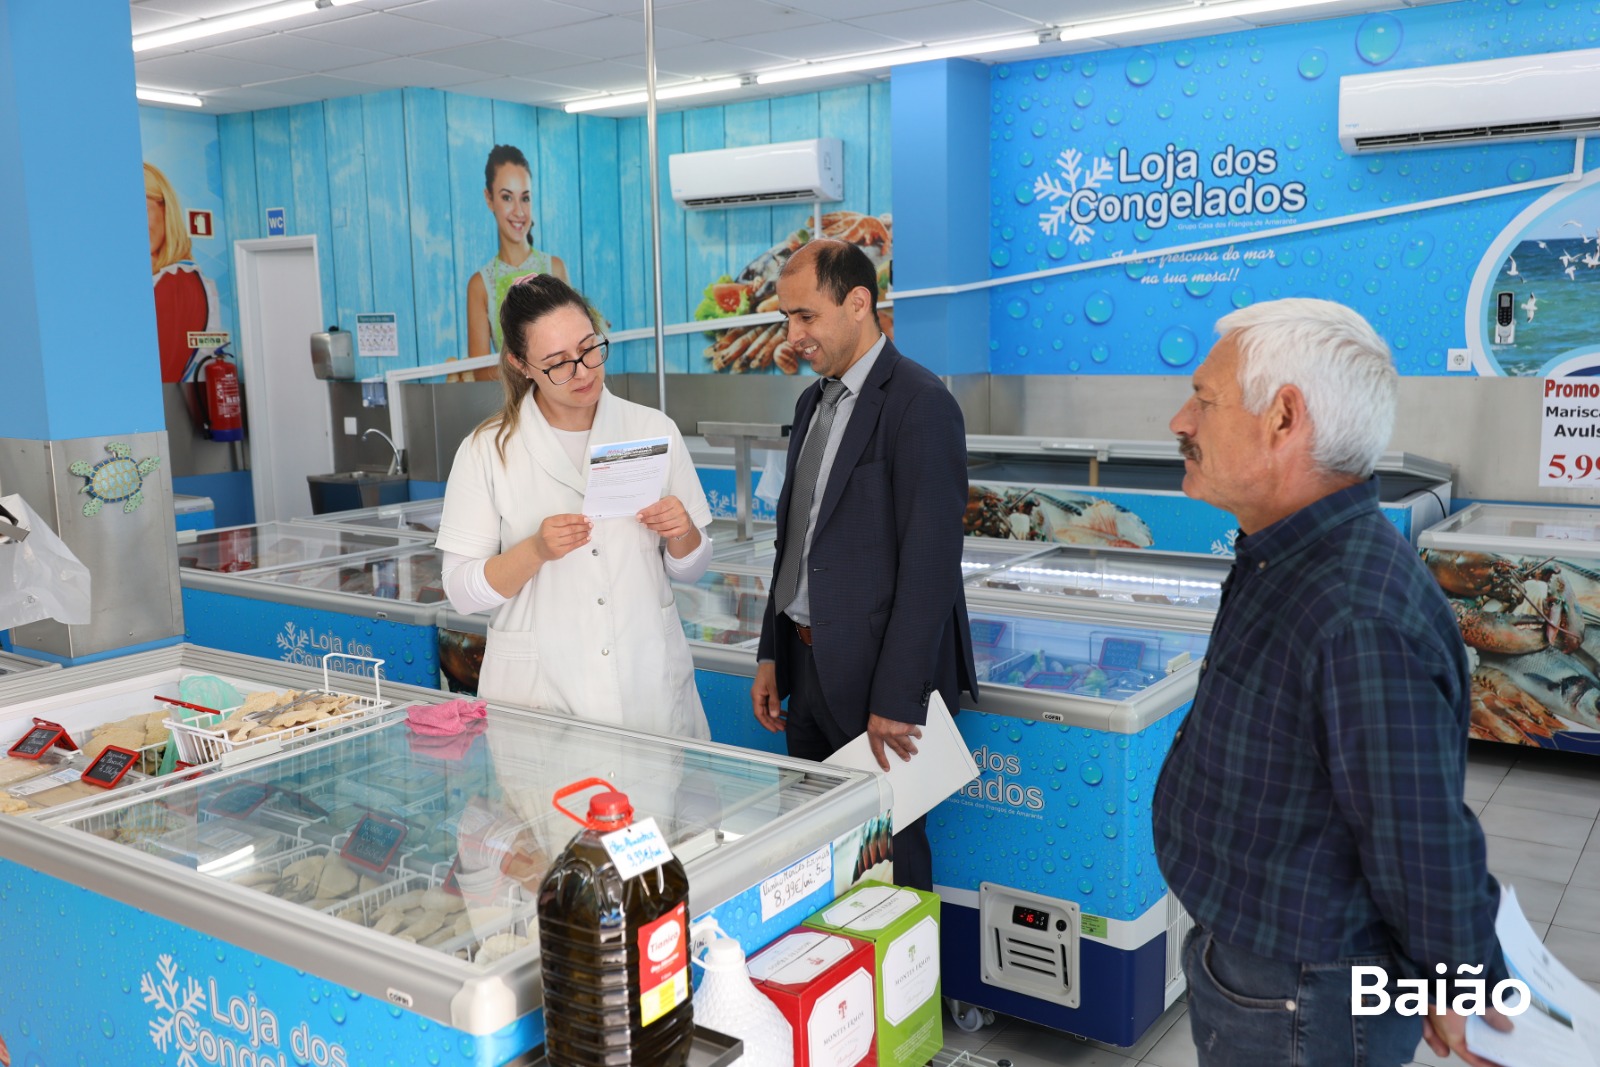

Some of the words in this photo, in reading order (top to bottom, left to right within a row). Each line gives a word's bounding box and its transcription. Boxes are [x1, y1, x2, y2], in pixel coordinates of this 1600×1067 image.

[1118, 143, 1199, 189] Loja
[1211, 144, 1278, 178] dos
[1069, 176, 1307, 229] Congelados
[268, 217, 283, 229] WC
[1177, 223, 1197, 231] Grupo
[1228, 220, 1253, 229] Frangos
[1222, 245, 1240, 261] do
[1243, 248, 1275, 260] mar
[1141, 275, 1160, 285] na
[1162, 272, 1188, 285] sua
[1191, 268, 1241, 283] mesa!!
[1544, 379, 1600, 398] Promo
[1546, 406, 1600, 418] Marisc
[309, 627, 343, 654] Loja
[347, 638, 374, 659] dos
[971, 745, 1021, 775] dos
[961, 798, 975, 807] Casa
[974, 801, 985, 809] dos
[985, 803, 1007, 814] Frangos
[1016, 809, 1044, 820] Amarante
[895, 966, 915, 986] MONTES
[208, 976, 280, 1049] Loja
[291, 1022, 350, 1067] dos
[823, 1024, 846, 1046] MONTES
